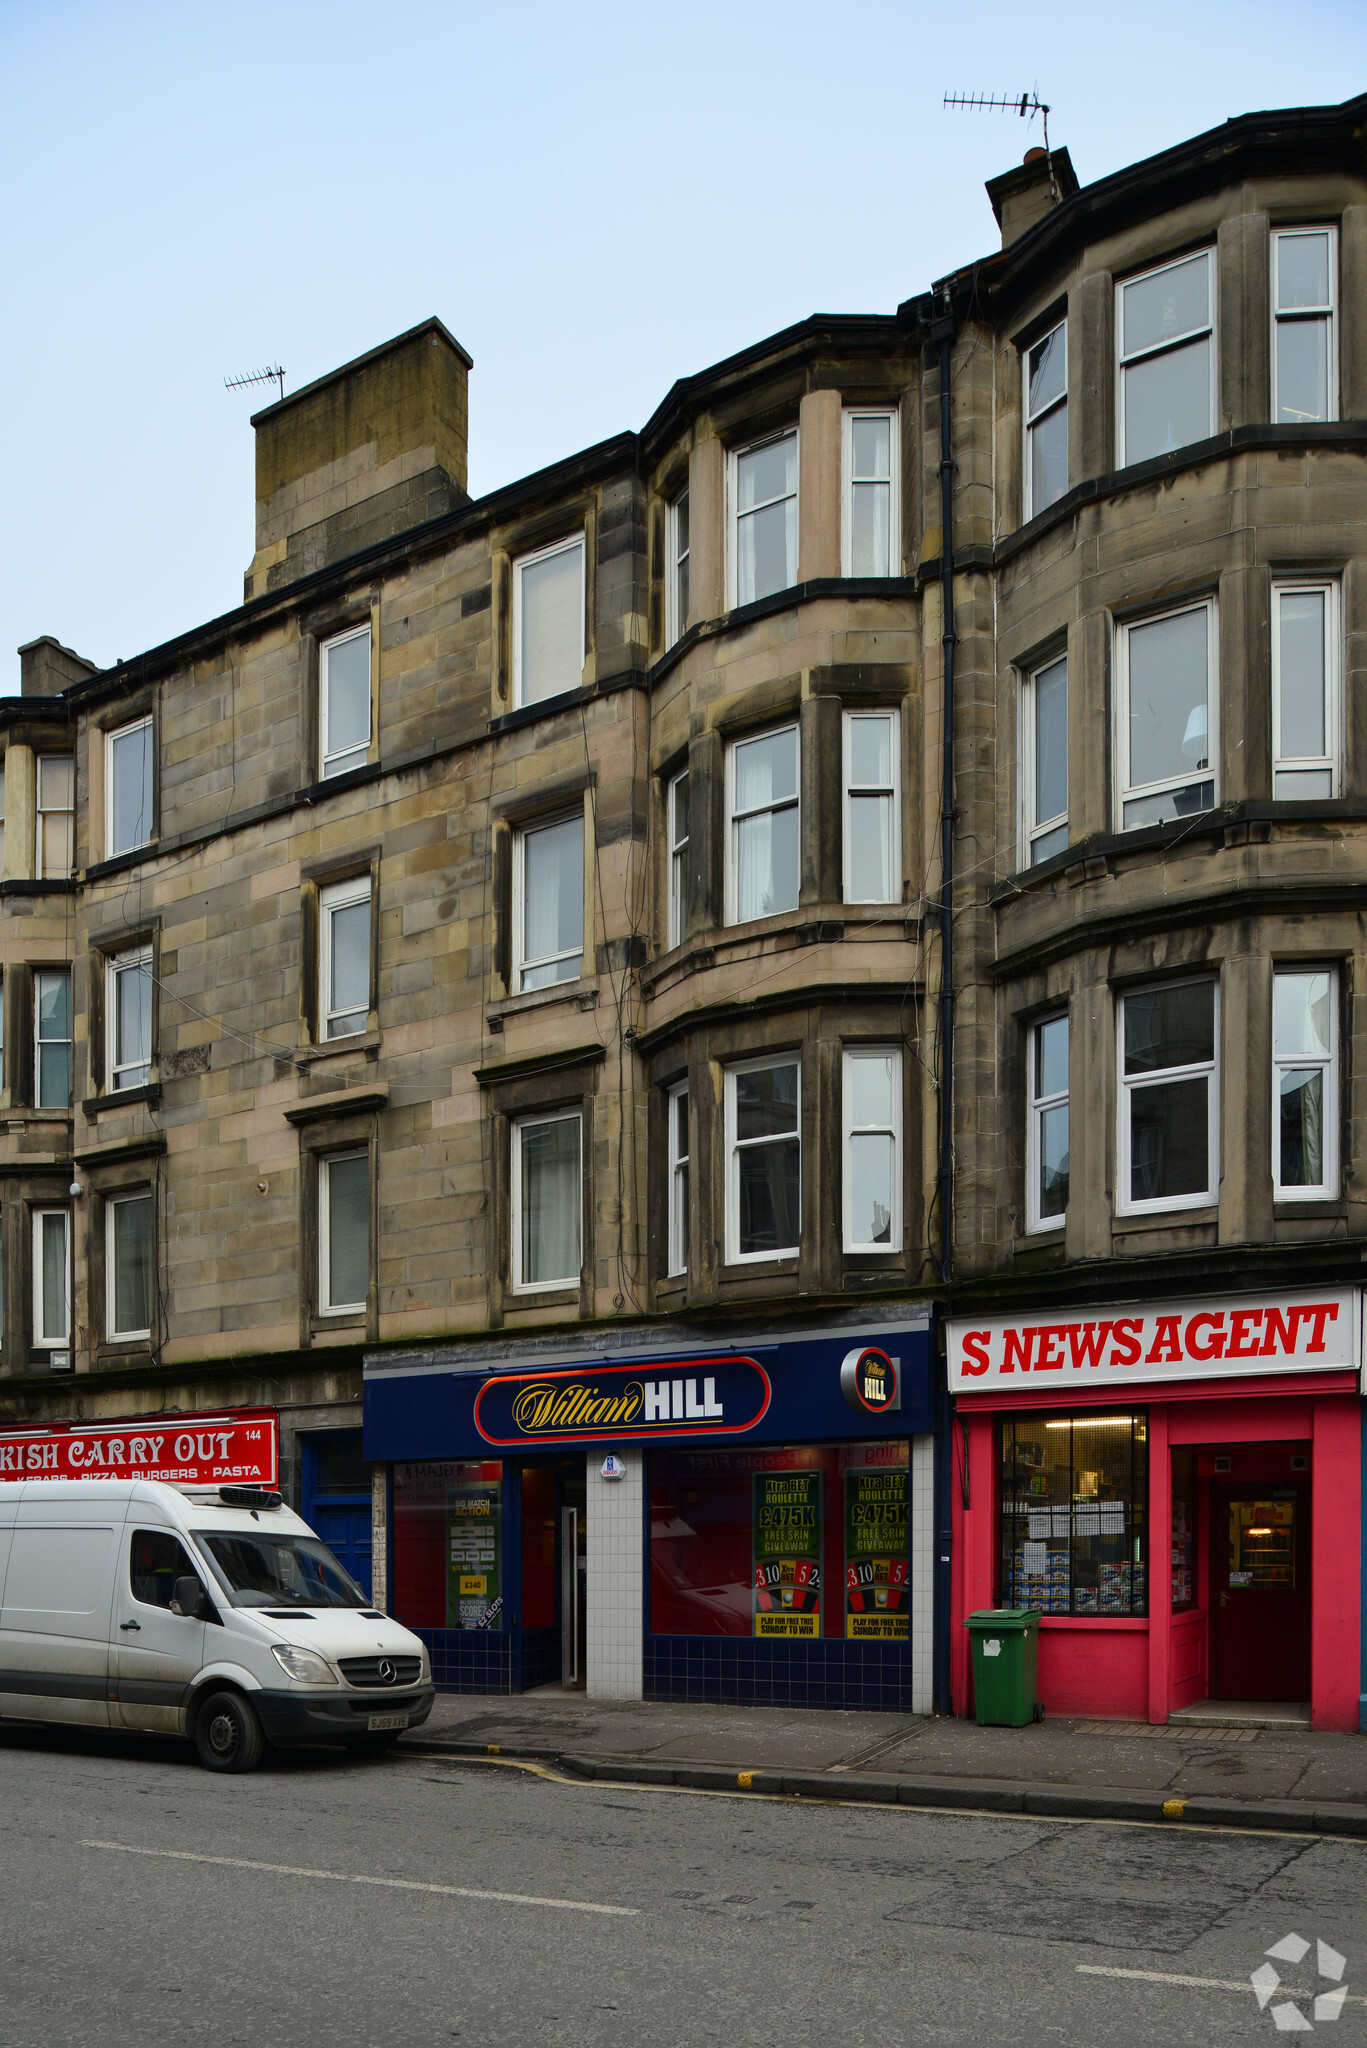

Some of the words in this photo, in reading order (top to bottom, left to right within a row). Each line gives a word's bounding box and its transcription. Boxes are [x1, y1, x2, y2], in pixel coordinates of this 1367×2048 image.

[960, 1331, 991, 1376] S
[865, 1360, 886, 1377] William
[865, 1377, 886, 1400] HILL
[512, 1382, 644, 1430] William
[644, 1377, 723, 1420] HILL
[245, 1430, 262, 1440] 144
[0, 1443, 60, 1471] KISH
[68, 1436, 164, 1467] CARRY
[174, 1432, 235, 1462] OUT
[81, 1472, 118, 1480] PIZZA
[132, 1468, 198, 1480] BURGERS
[212, 1466, 262, 1476] PASTA
[766, 1480, 788, 1492] Xtra
[790, 1478, 809, 1492] BET
[858, 1476, 882, 1489] Xtra
[884, 1475, 905, 1489] BET
[766, 1493, 808, 1504] ROULETTE
[858, 1490, 904, 1500] ROULETTE
[456, 1506, 490, 1516] ACTION
[760, 1506, 815, 1527] £475K
[852, 1503, 909, 1526] £475K
[765, 1530, 786, 1540] FREE
[788, 1529, 809, 1540] SPIN
[858, 1528, 880, 1538] FREE
[882, 1528, 904, 1538] SPIN
[764, 1541, 809, 1552] GIVEAWAY
[857, 1540, 904, 1550] GIVEAWAY
[766, 1565, 780, 1582] 10
[800, 1566, 807, 1582] 5
[858, 1564, 872, 1582] 10
[875, 1572, 888, 1580] BET
[894, 1565, 902, 1582] 5
[460, 1606, 486, 1616] SCORE?
[486, 1596, 504, 1618] SLOTS
[761, 1617, 774, 1625] PLAY
[774, 1617, 786, 1625] FOR
[853, 1618, 867, 1626] PLAY
[868, 1618, 880, 1626] FOR
[880, 1618, 894, 1626] FREE
[895, 1618, 909, 1626] THIS
[761, 1625, 788, 1634] SUNDAY
[789, 1626, 798, 1634] TO
[799, 1626, 814, 1634] WIN
[853, 1626, 881, 1636] SUNDAY
[882, 1627, 892, 1636] TO
[894, 1627, 909, 1636] WIN
